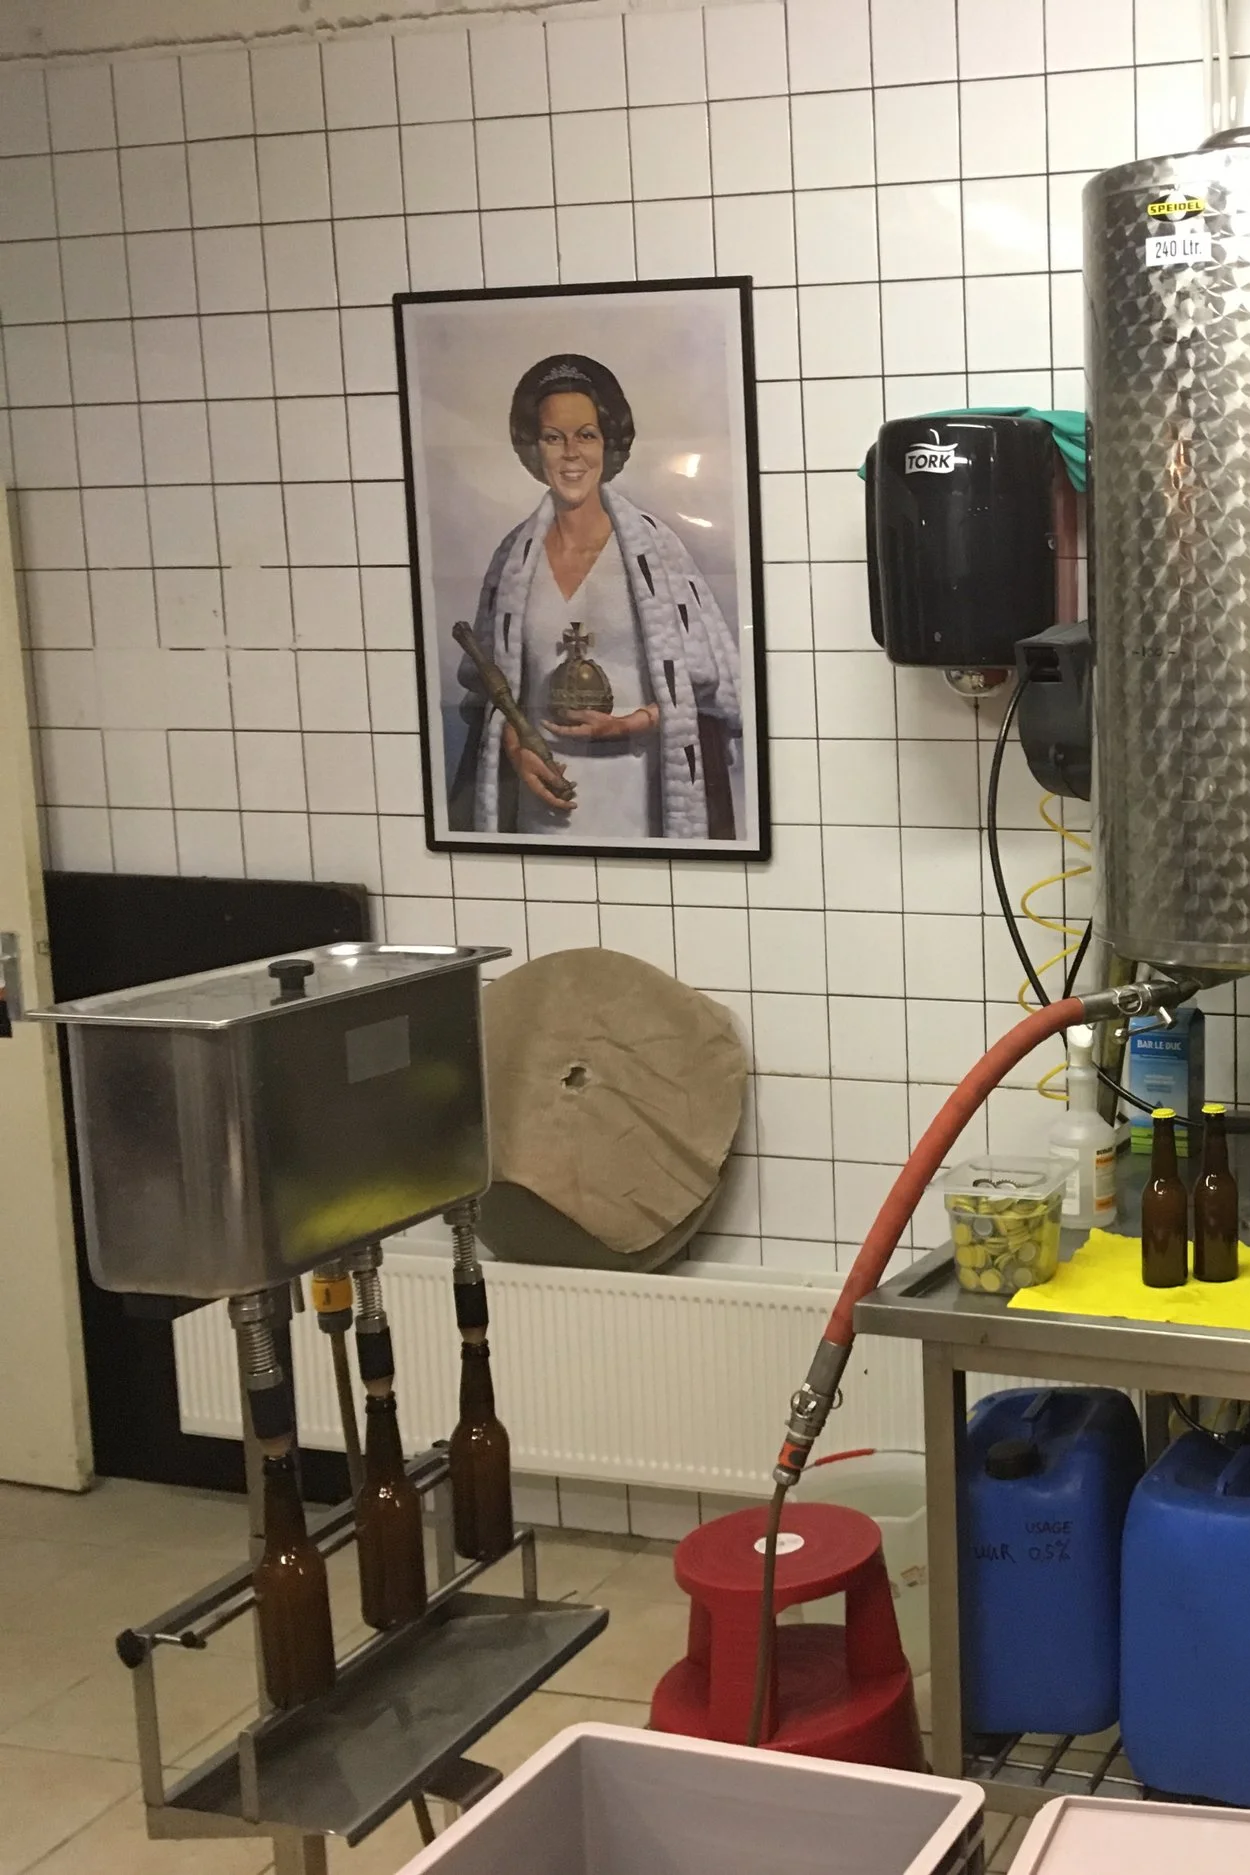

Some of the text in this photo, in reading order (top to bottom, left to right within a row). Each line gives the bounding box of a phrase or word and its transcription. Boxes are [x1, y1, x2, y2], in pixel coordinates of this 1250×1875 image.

[1149, 201, 1202, 214] SPEIDEL
[1155, 239, 1202, 259] 240 Ltr.
[907, 454, 951, 470] TORK
[1136, 1039, 1154, 1049] BAR
[1025, 1521, 1073, 1534] USAGE
